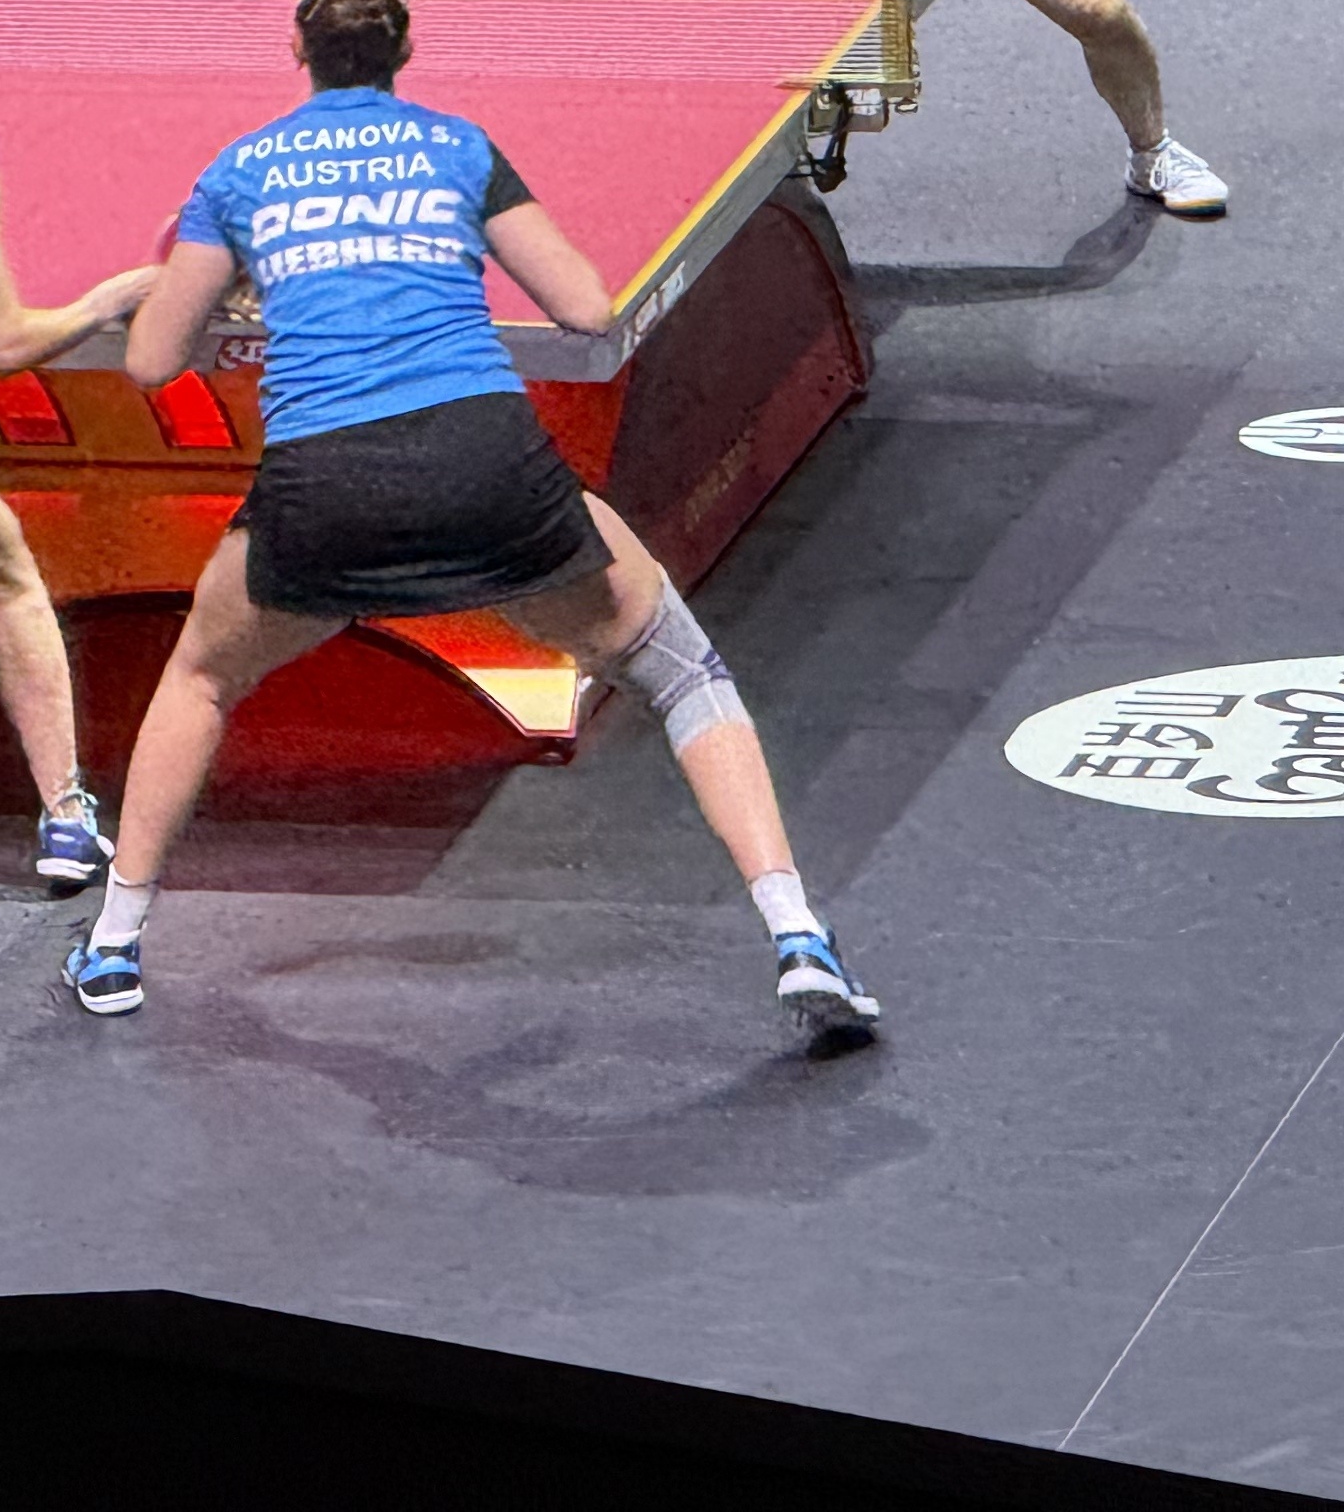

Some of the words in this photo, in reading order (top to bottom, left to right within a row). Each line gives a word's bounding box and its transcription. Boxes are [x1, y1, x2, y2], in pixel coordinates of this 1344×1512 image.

[235, 121, 423, 169] POLCANOVA
[430, 124, 461, 147] S.
[261, 151, 436, 193] AUSTRIA
[252, 188, 464, 249] DONIC
[1056, 690, 1246, 781] 百岁山
